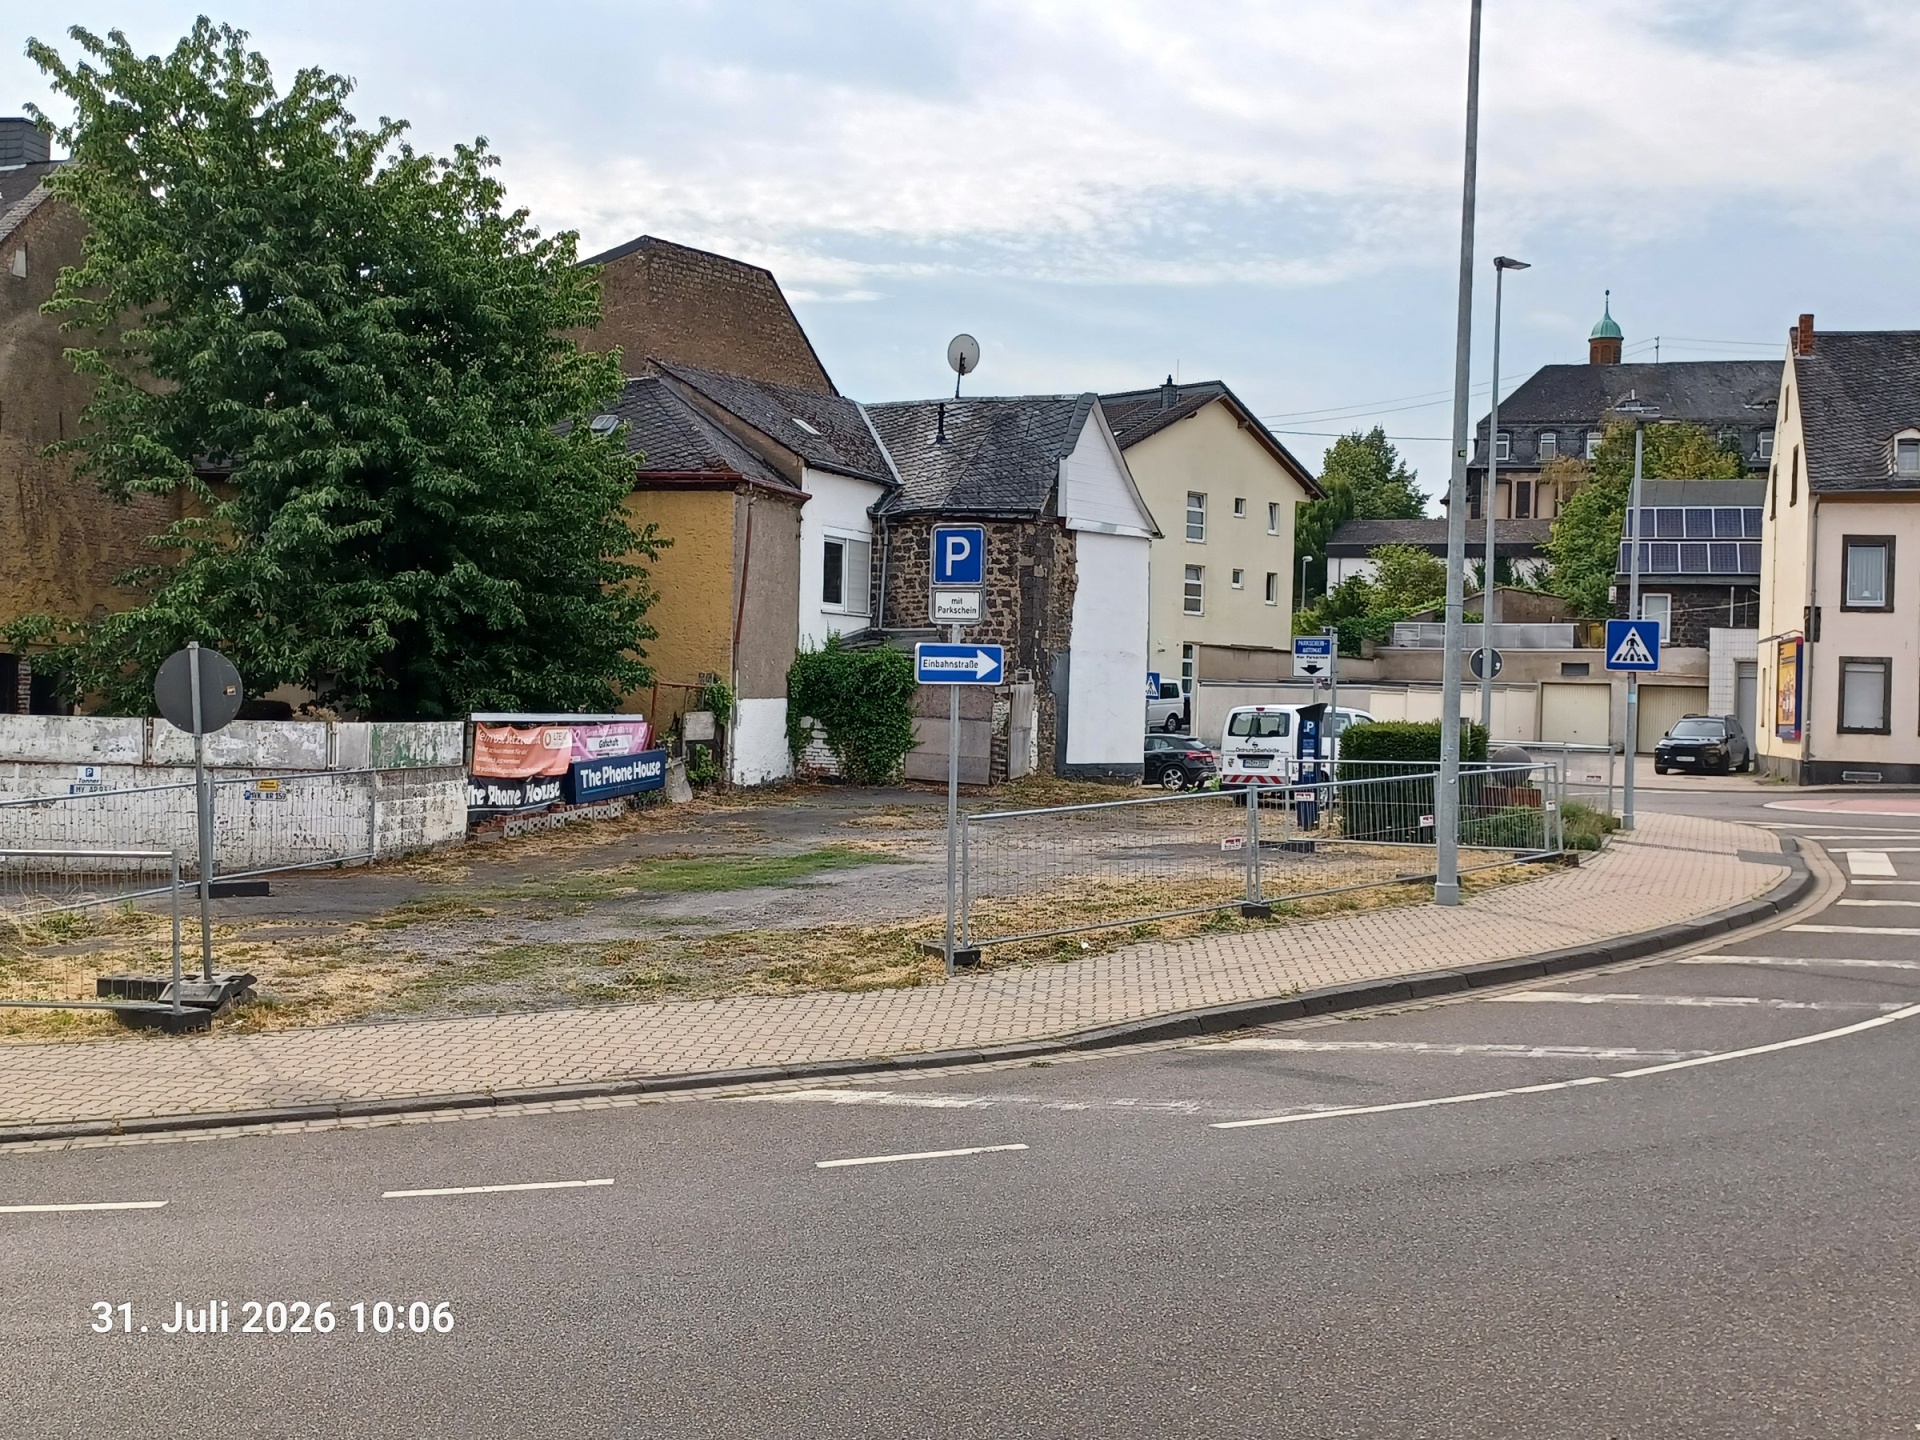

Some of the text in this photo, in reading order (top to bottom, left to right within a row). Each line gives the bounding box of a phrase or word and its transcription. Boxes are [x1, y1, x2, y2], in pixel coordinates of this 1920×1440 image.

[946, 536, 971, 576] P
[951, 597, 963, 605] mit
[937, 606, 977, 614] Parkschein
[923, 659, 979, 669] Einbahnstraße
[580, 761, 661, 789] The Phone House
[487, 784, 521, 806] Phone
[524, 781, 560, 804] House
